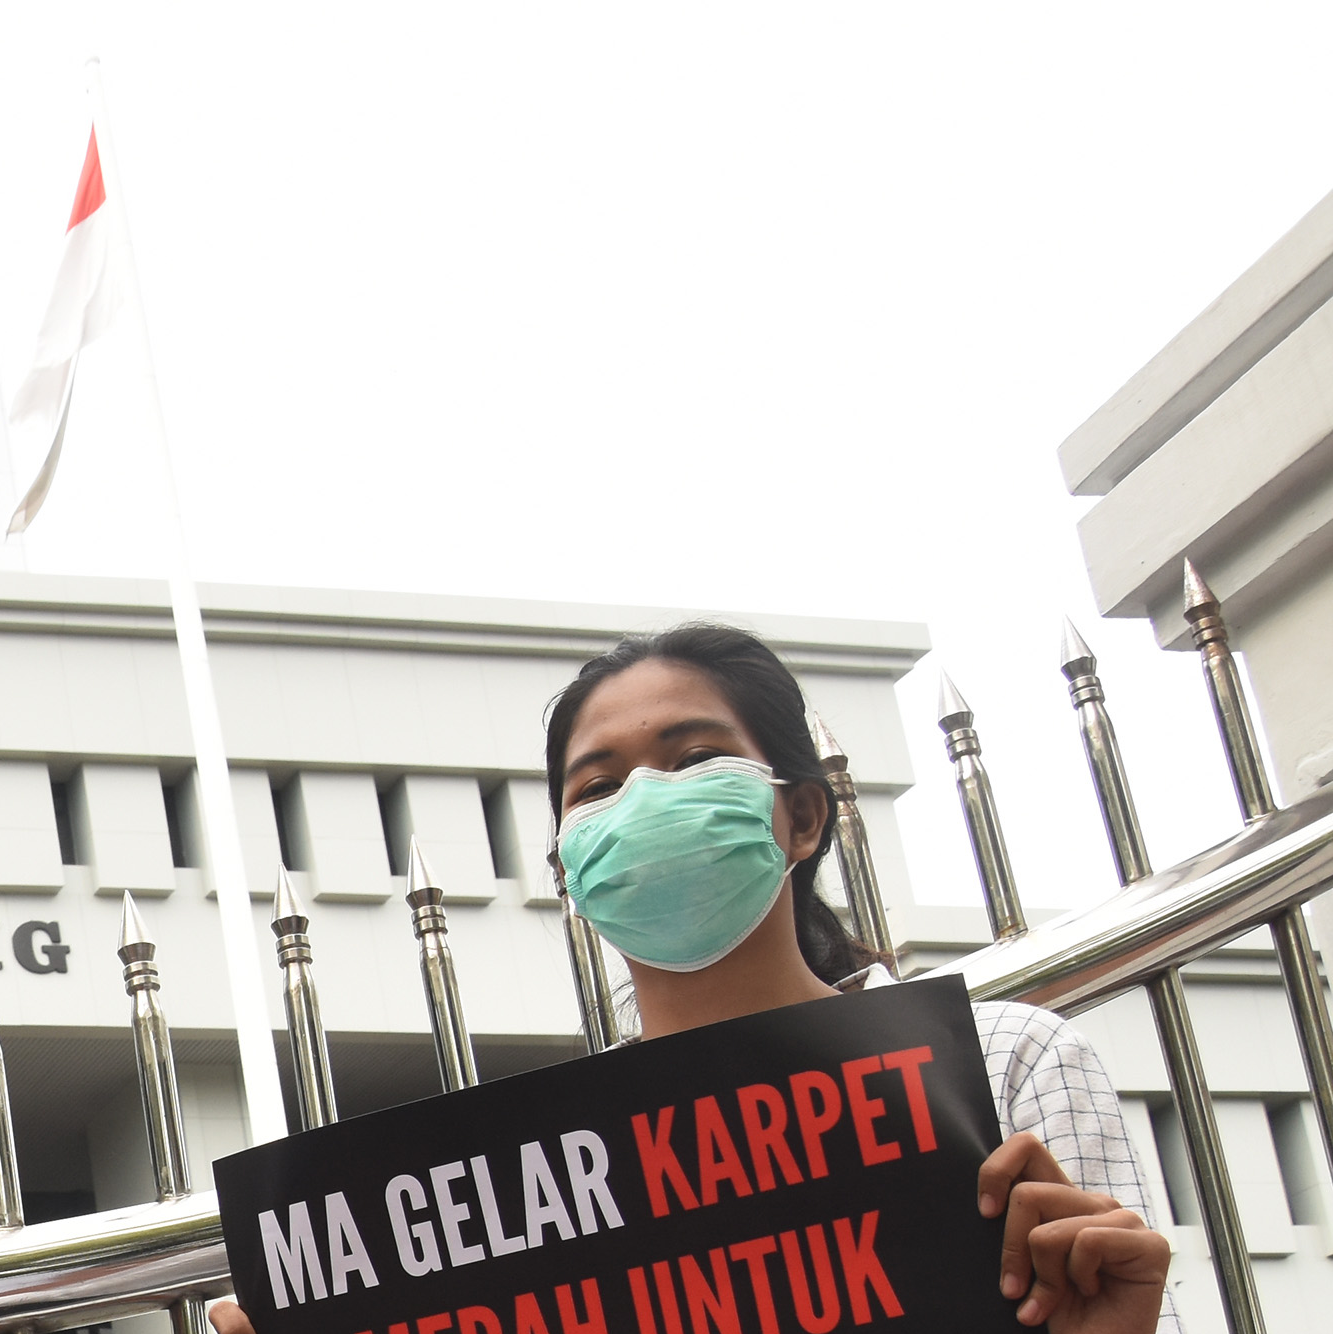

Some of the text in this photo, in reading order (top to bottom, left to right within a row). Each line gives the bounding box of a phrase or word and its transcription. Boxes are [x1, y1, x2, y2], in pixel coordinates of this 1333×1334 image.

[259, 1046, 938, 1310] MA GELAR KARPET
